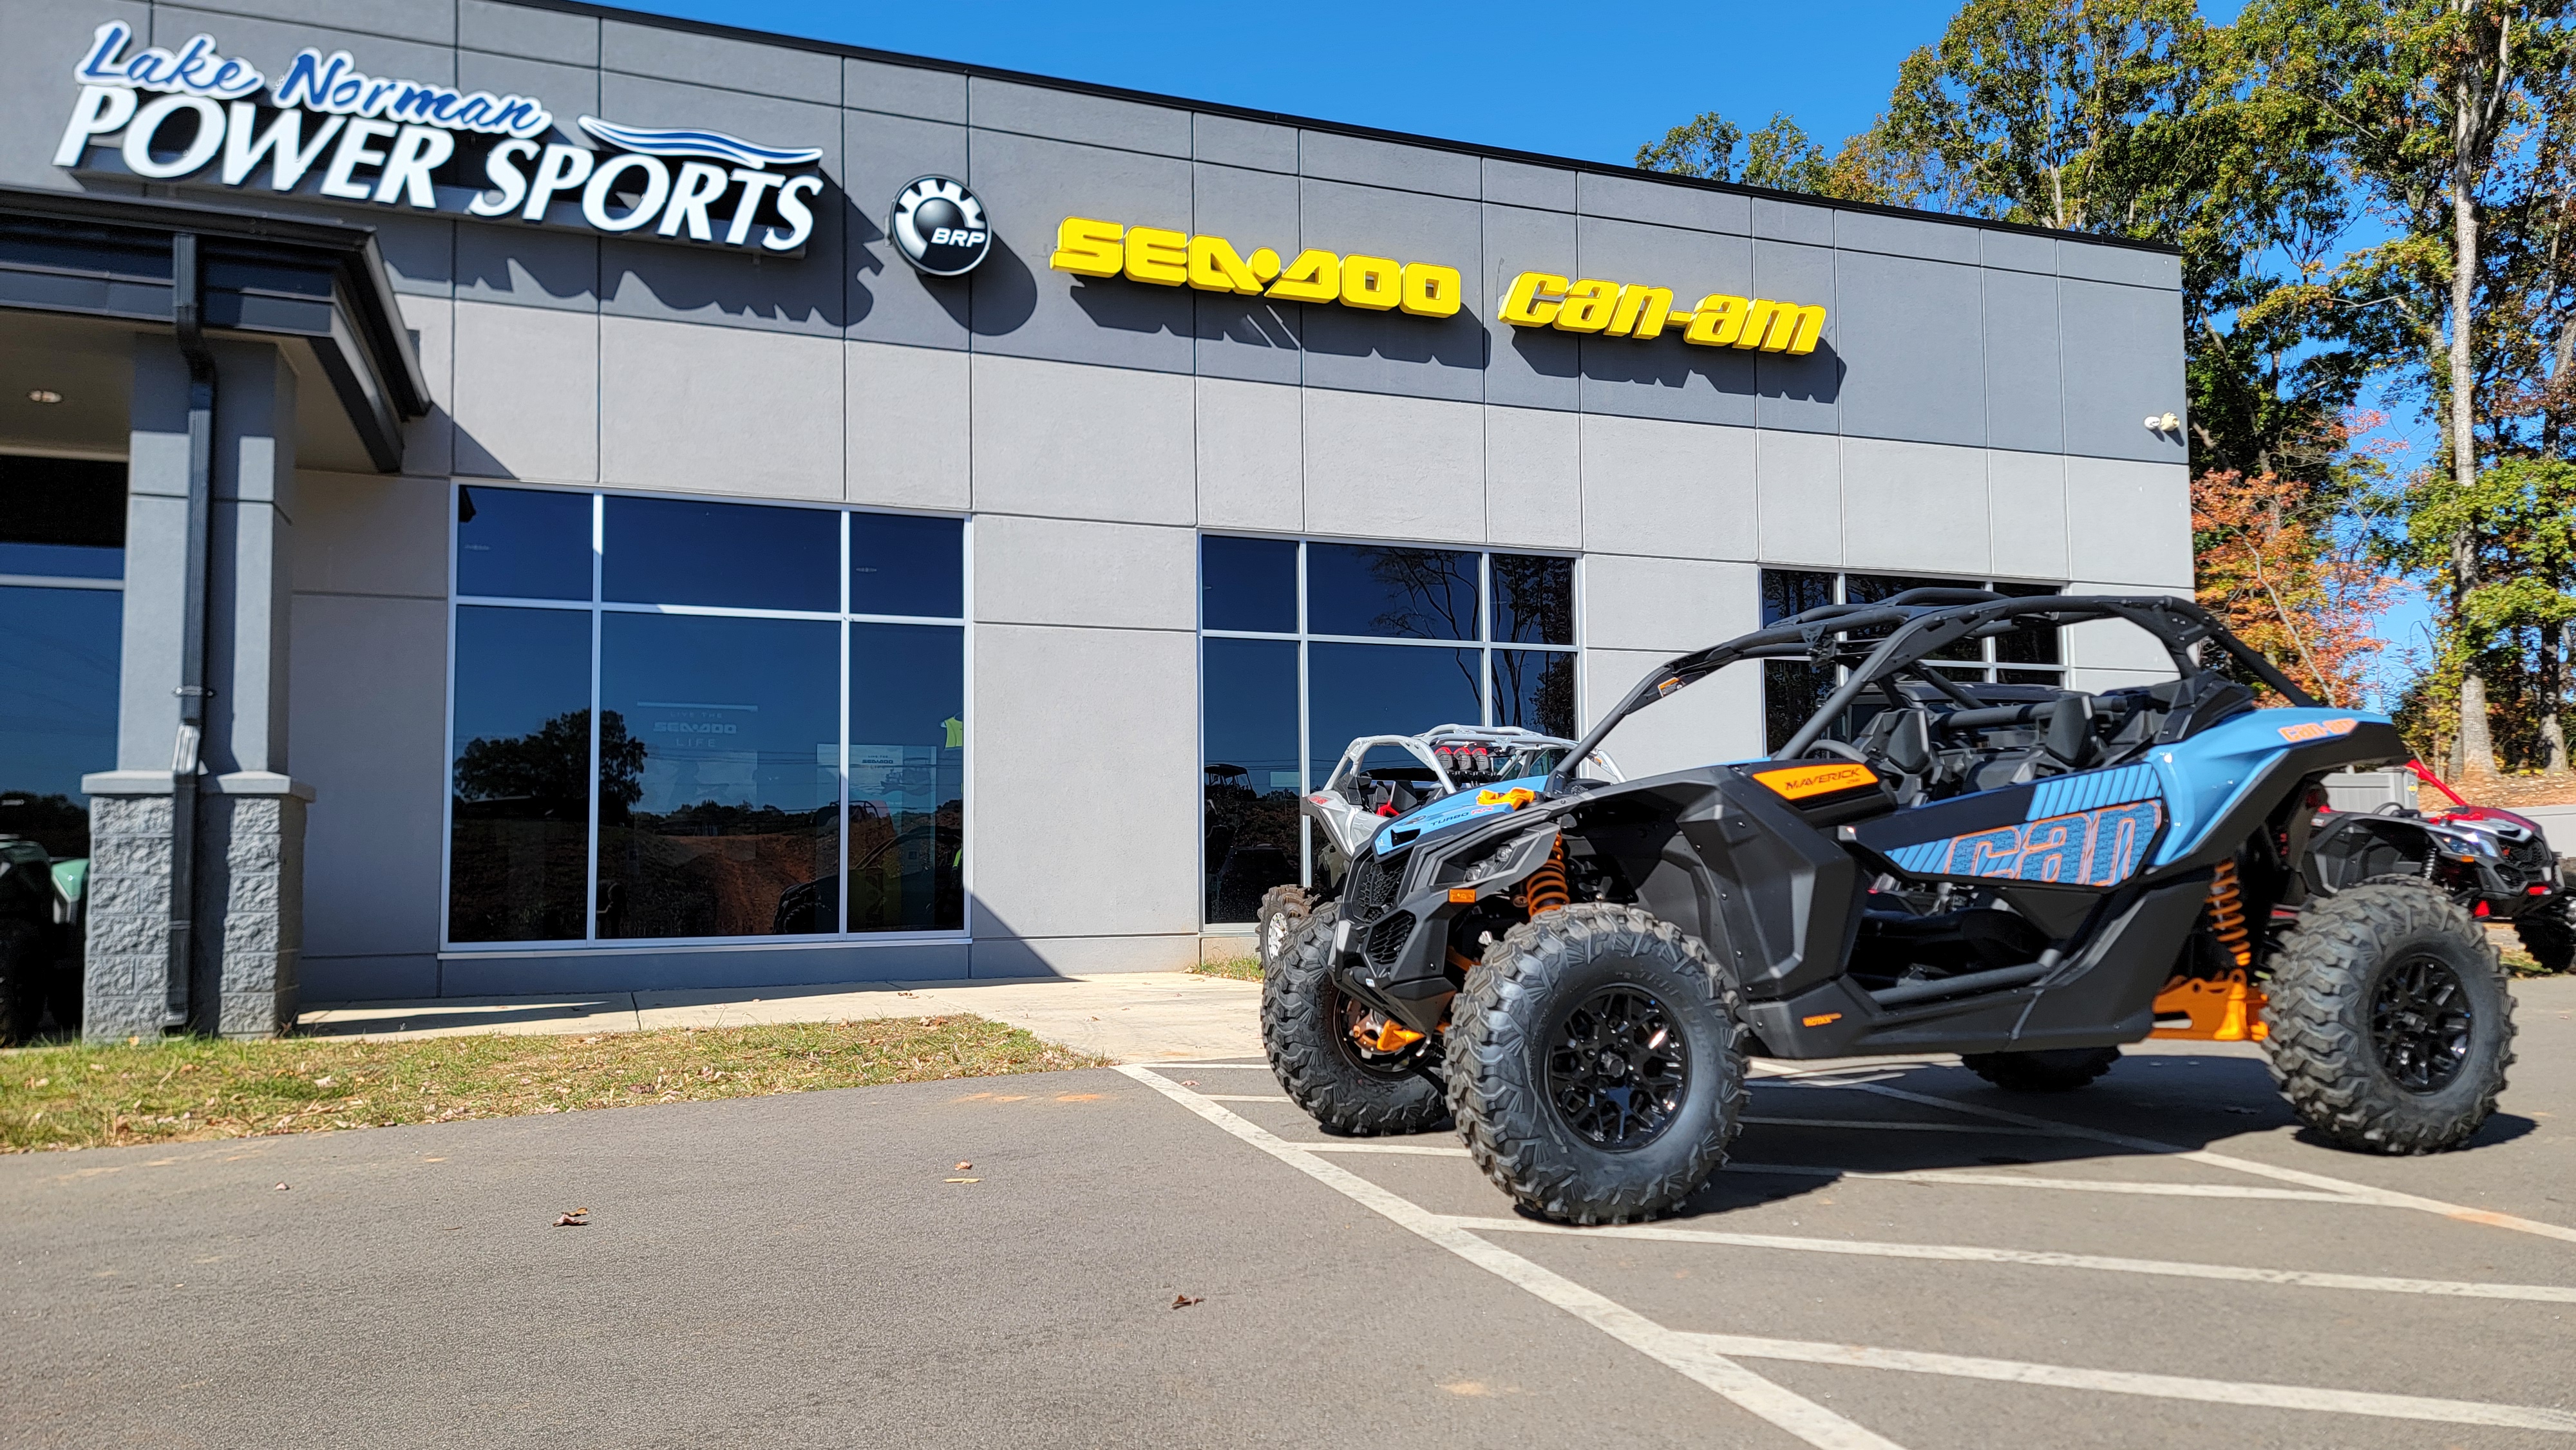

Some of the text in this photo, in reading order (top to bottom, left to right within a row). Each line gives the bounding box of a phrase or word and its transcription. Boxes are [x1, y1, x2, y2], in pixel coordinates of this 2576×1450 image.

[78, 23, 547, 134] Lake Norman
[52, 85, 824, 252] POWER SPORTS
[930, 227, 986, 248] BRP
[1497, 270, 1827, 357] can-am
[676, 738, 717, 747] LIFE
[1785, 767, 1861, 791] MAVERICK
[1430, 812, 1470, 827] TURBO
